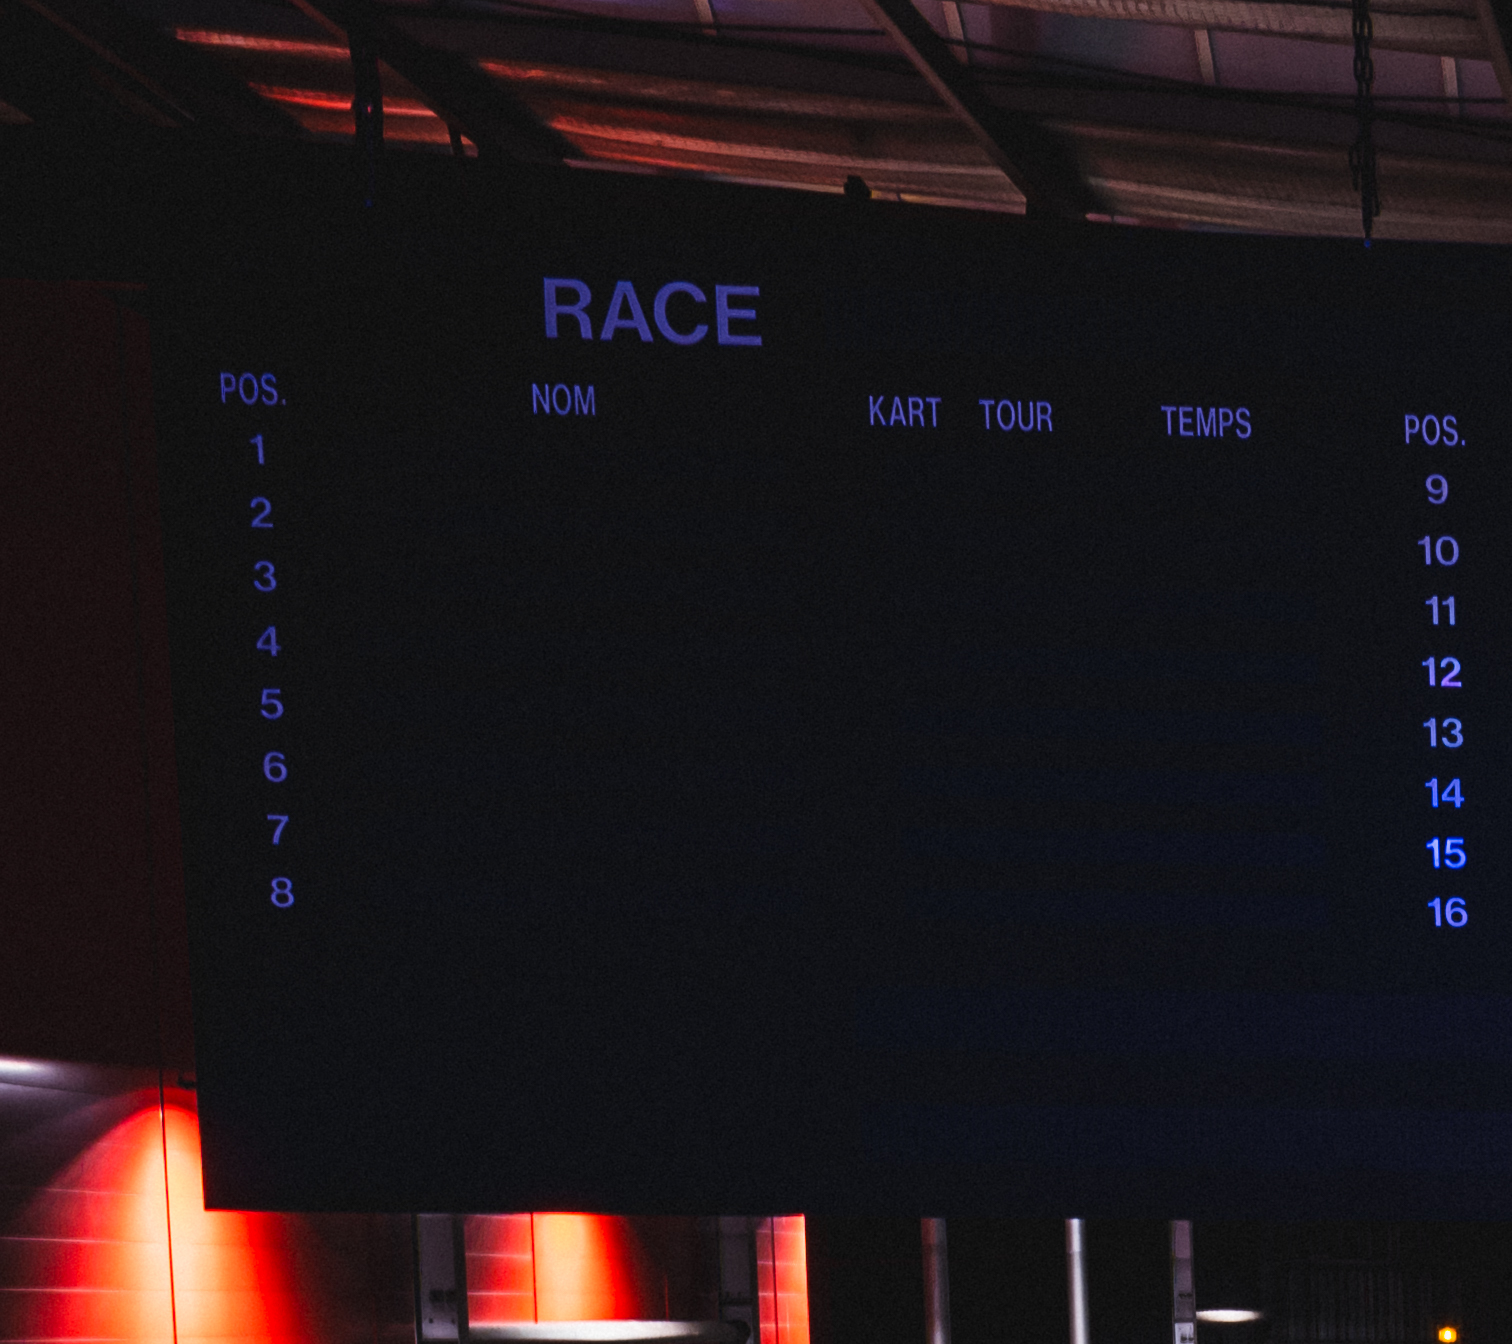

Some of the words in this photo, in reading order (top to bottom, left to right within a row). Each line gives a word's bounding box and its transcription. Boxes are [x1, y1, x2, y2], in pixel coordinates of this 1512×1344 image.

[542, 276, 763, 347] RACE
[219, 371, 287, 406] POS.
[531, 382, 596, 416] NOM
[868, 395, 942, 428] KART
[978, 398, 1053, 432] TOUR
[1160, 405, 1252, 440] TEMPS
[1404, 413, 1466, 447] POS.
[250, 433, 265, 465] 1
[1425, 473, 1449, 505] 9
[249, 496, 274, 529] 2
[1417, 535, 1460, 567] 10
[253, 560, 278, 592] 3
[1425, 595, 1456, 626] 11
[255, 625, 281, 657] 4
[1421, 656, 1463, 688] 12
[260, 688, 285, 720] 5
[1422, 717, 1464, 749] 13
[262, 751, 288, 783] 6
[1424, 776, 1466, 809] 14
[266, 814, 290, 846] 7
[1425, 836, 1468, 870] 15
[270, 876, 295, 909] 8
[1427, 896, 1469, 928] 16
